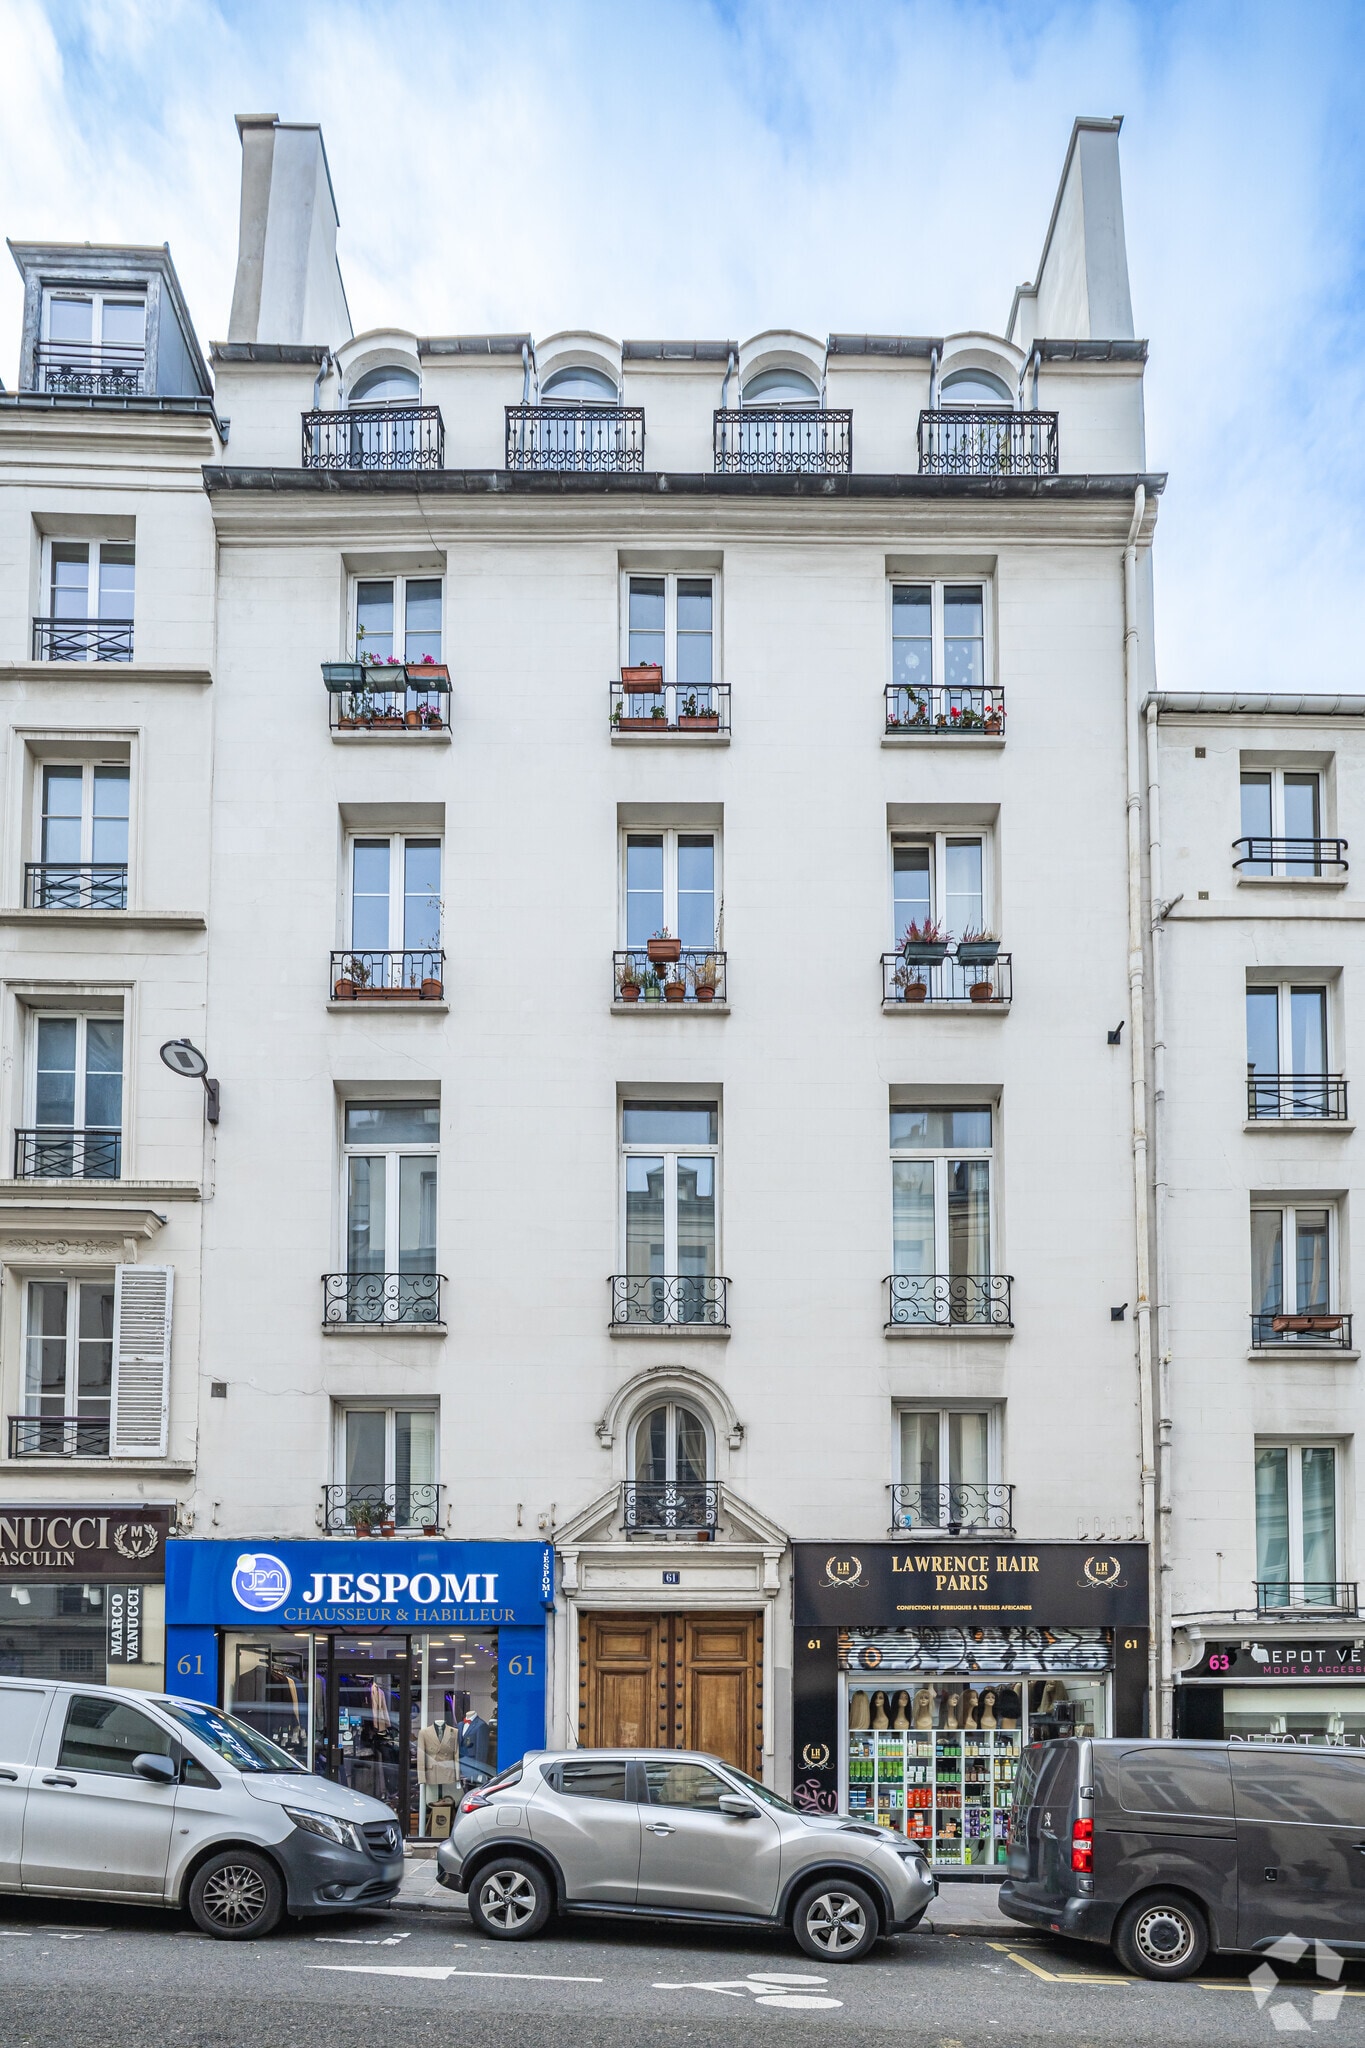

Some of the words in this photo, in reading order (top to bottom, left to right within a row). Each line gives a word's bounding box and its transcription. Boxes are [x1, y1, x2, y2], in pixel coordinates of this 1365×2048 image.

[131, 1526, 143, 1537] M
[132, 1540, 142, 1552] V
[837, 1561, 850, 1571] LH
[892, 1556, 989, 1572] LAWRENCE
[996, 1556, 1040, 1572] HAIR
[1095, 1562, 1108, 1572] LH
[541, 1549, 550, 1598] JESPOMI
[666, 1573, 676, 1583] 61
[302, 1573, 499, 1604] JESPOMI
[935, 1575, 989, 1591] PARIS
[283, 1608, 391, 1621] CHAUSSEUR
[396, 1608, 409, 1621] &
[414, 1608, 516, 1621] HABILLEUR
[111, 1594, 124, 1656] MARCO
[127, 1588, 140, 1662] VANUCCI
[807, 1639, 821, 1649] 61
[1124, 1639, 1138, 1649] 61
[1209, 1654, 1230, 1671] 63
[1260, 1650, 1326, 1663] EPOT
[177, 1654, 205, 1675] 61
[508, 1654, 536, 1676] 61
[1263, 1665, 1297, 1674] MODE
[1303, 1665, 1311, 1674] &
[1317, 1665, 1365, 1674] ACCESS
